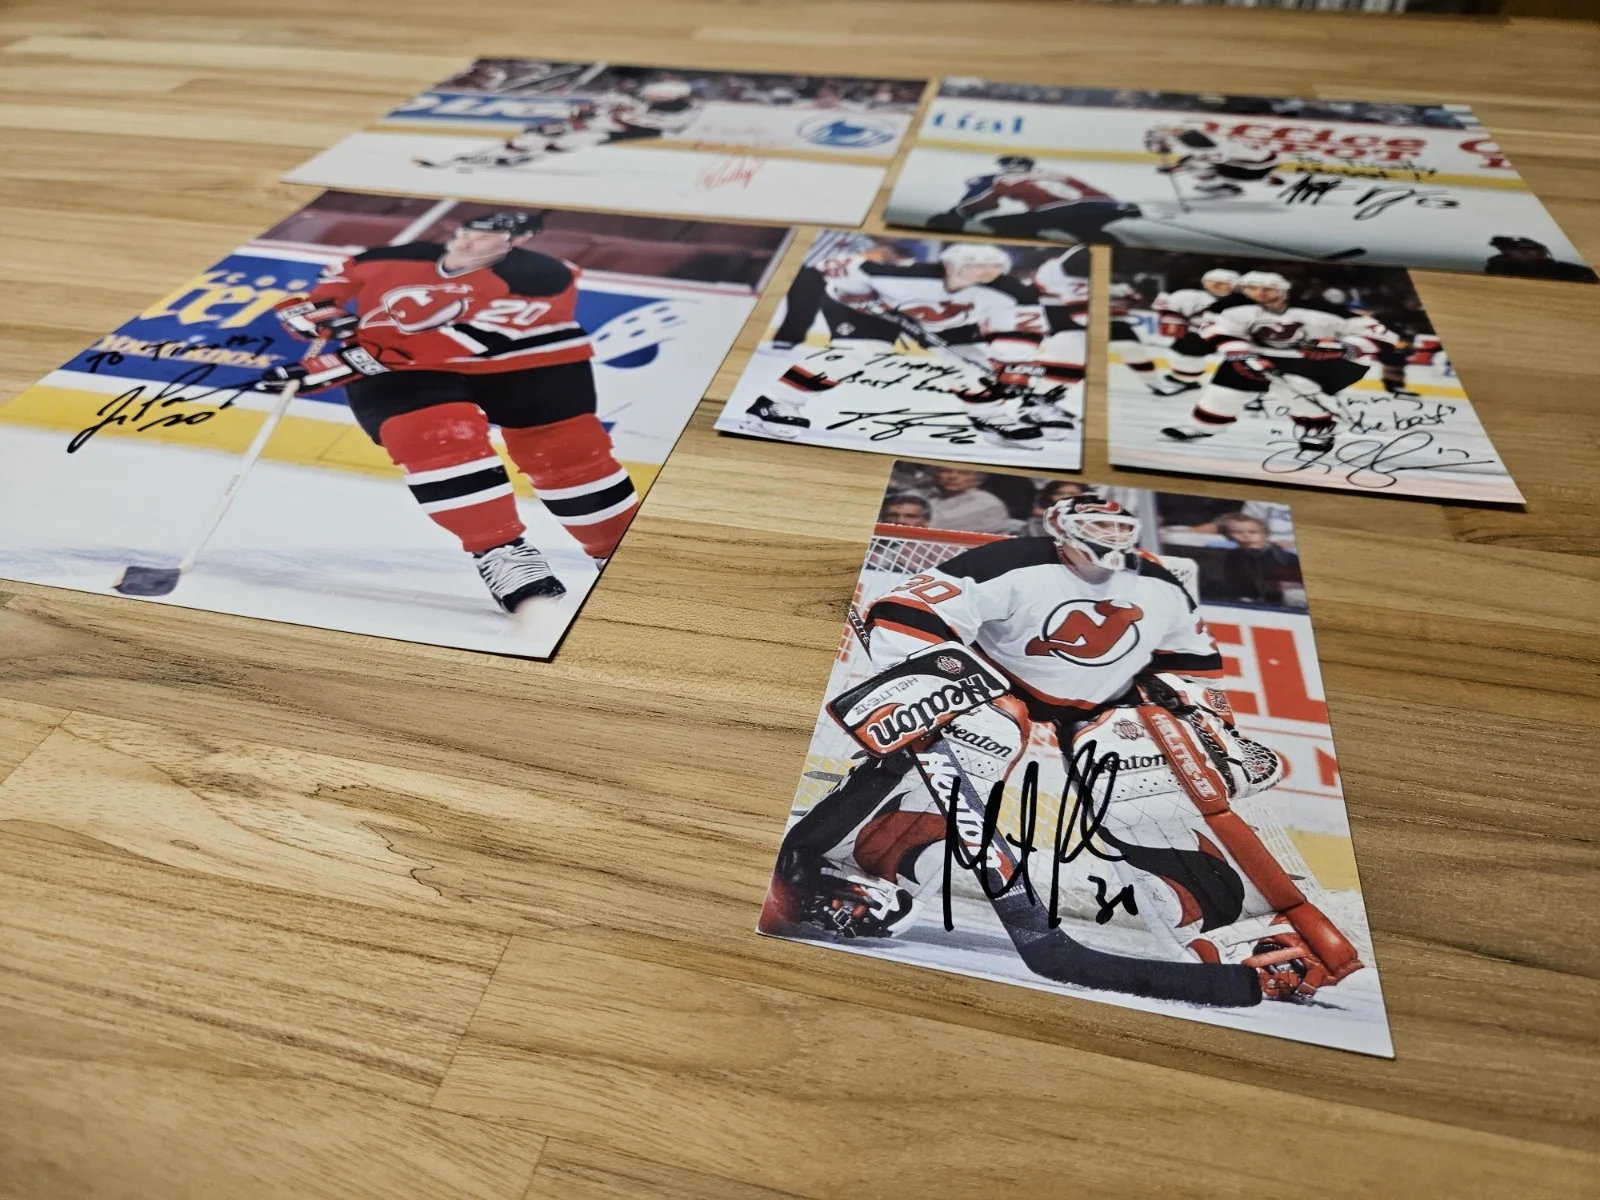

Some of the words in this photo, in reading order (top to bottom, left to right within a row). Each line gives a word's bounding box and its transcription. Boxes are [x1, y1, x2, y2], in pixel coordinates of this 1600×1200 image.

[475, 299, 551, 326] 20
[805, 346, 853, 361] To
[897, 574, 962, 604] 30
[866, 673, 992, 749] Heaton
